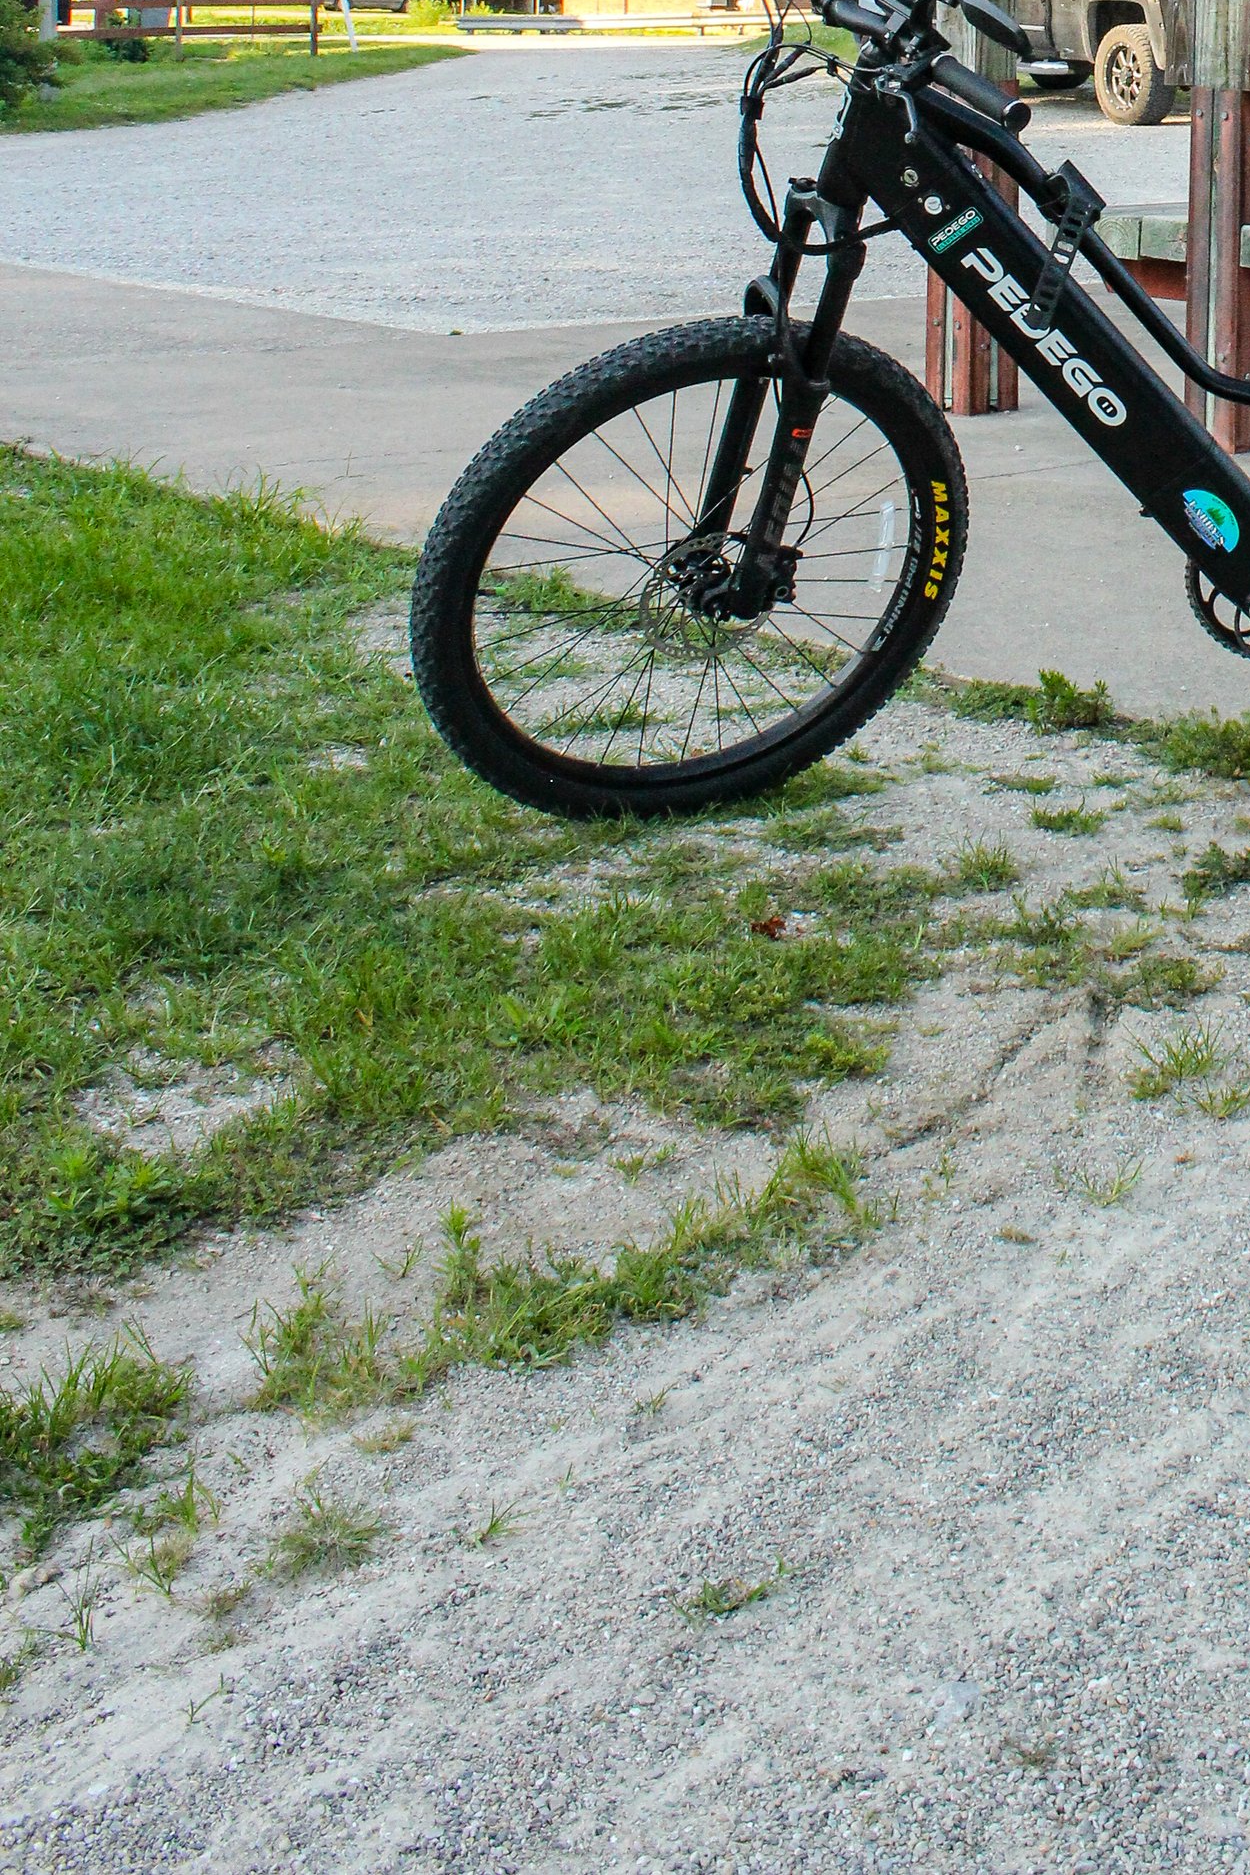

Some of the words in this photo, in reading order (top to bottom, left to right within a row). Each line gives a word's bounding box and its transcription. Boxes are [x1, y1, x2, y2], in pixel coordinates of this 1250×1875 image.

[931, 210, 976, 246] PEDEGO
[960, 247, 1128, 427] PEDEGO
[923, 480, 951, 601] MAXXIS
